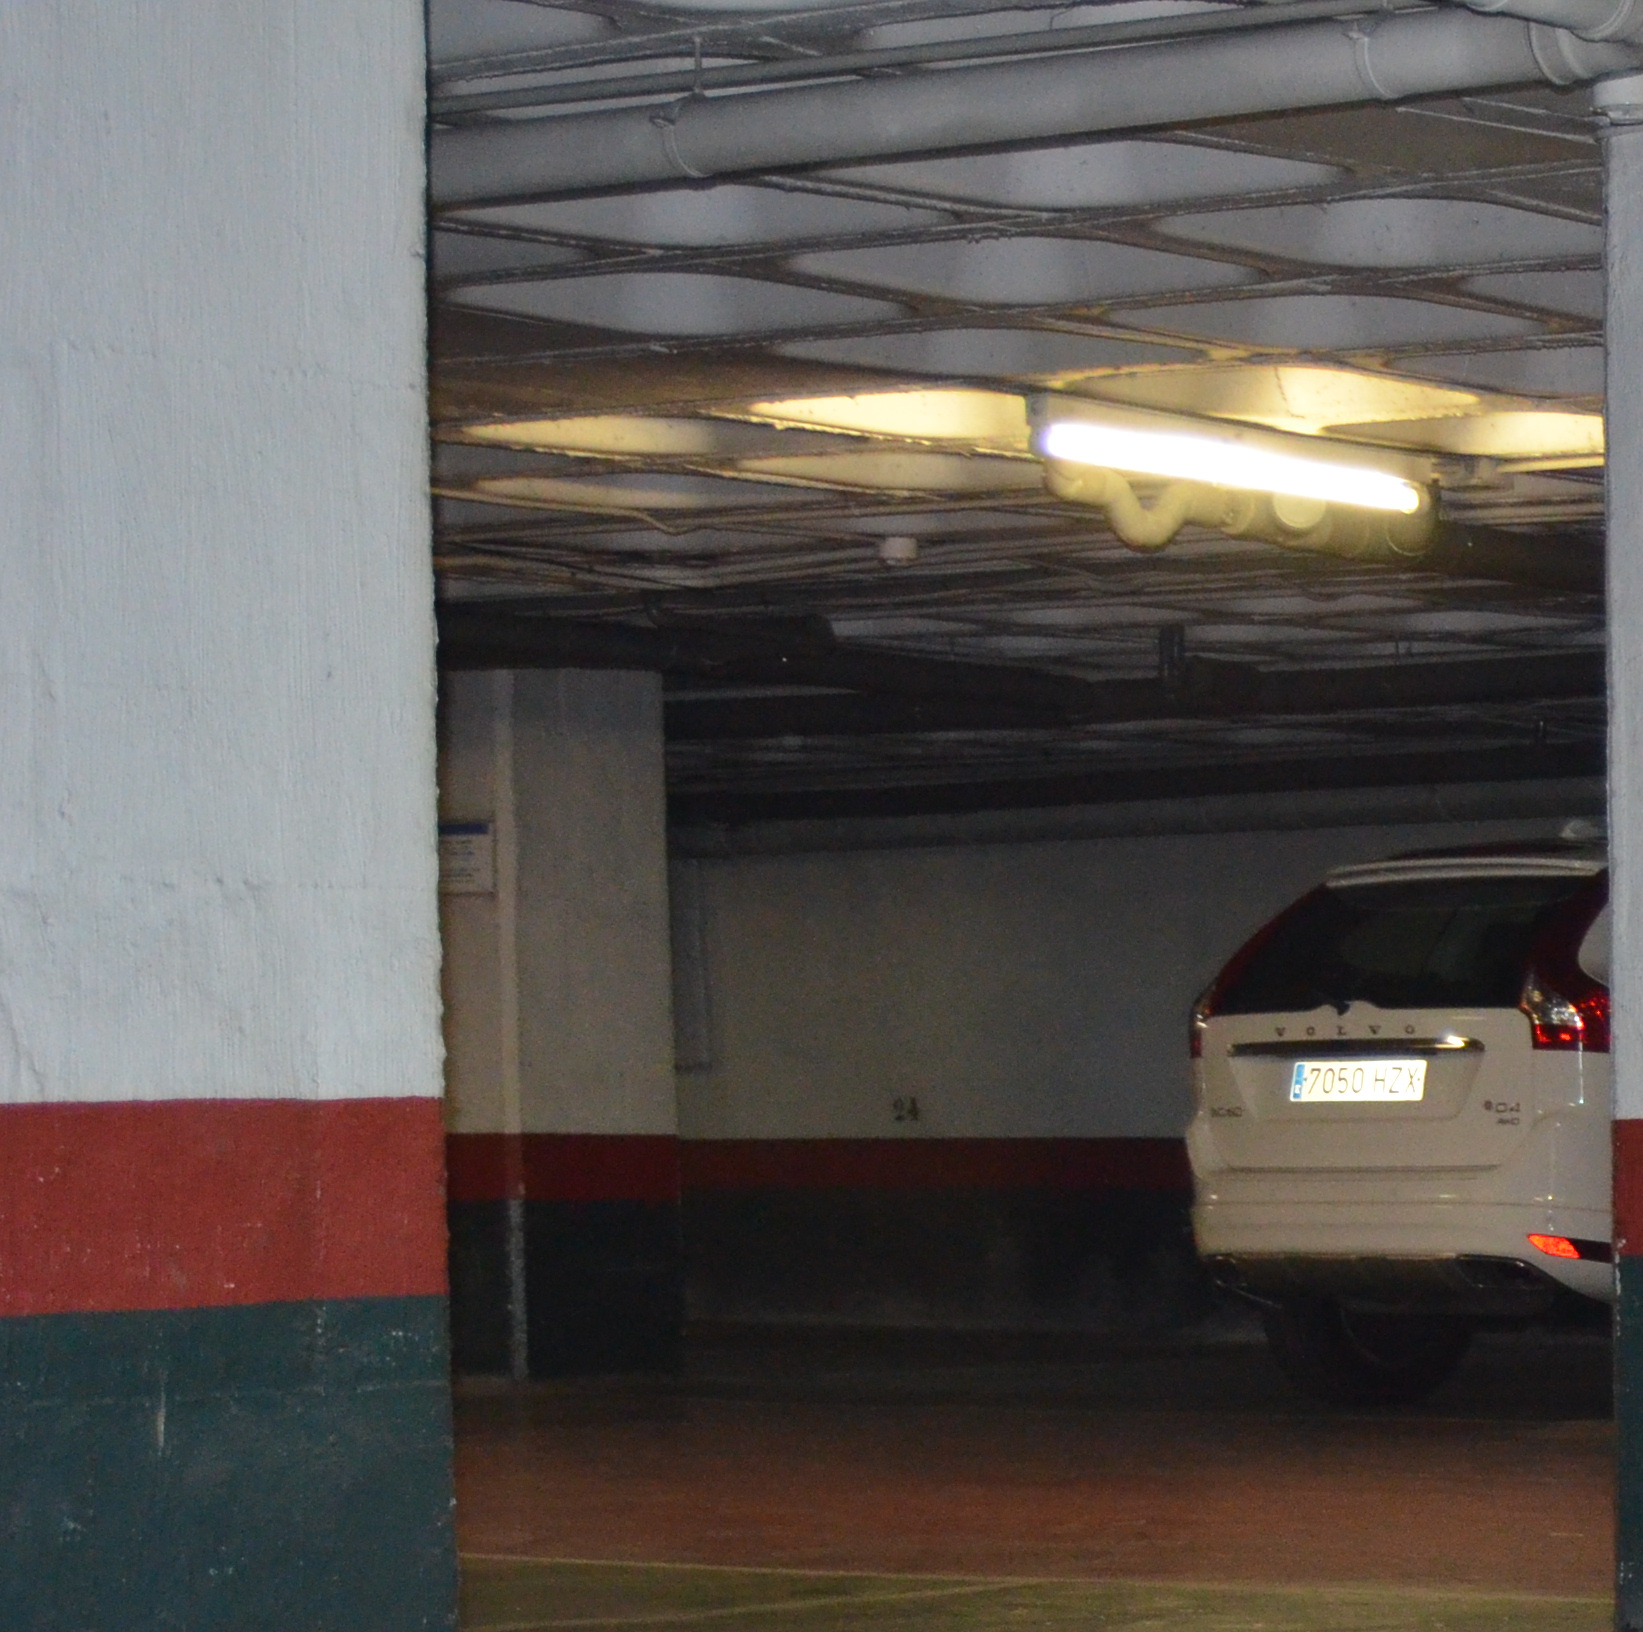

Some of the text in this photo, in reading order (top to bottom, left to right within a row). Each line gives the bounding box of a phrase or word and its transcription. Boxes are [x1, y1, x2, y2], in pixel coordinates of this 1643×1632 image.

[1275, 1025, 1416, 1037] VOLVO
[1308, 1067, 1419, 1094] 7050 HZX
